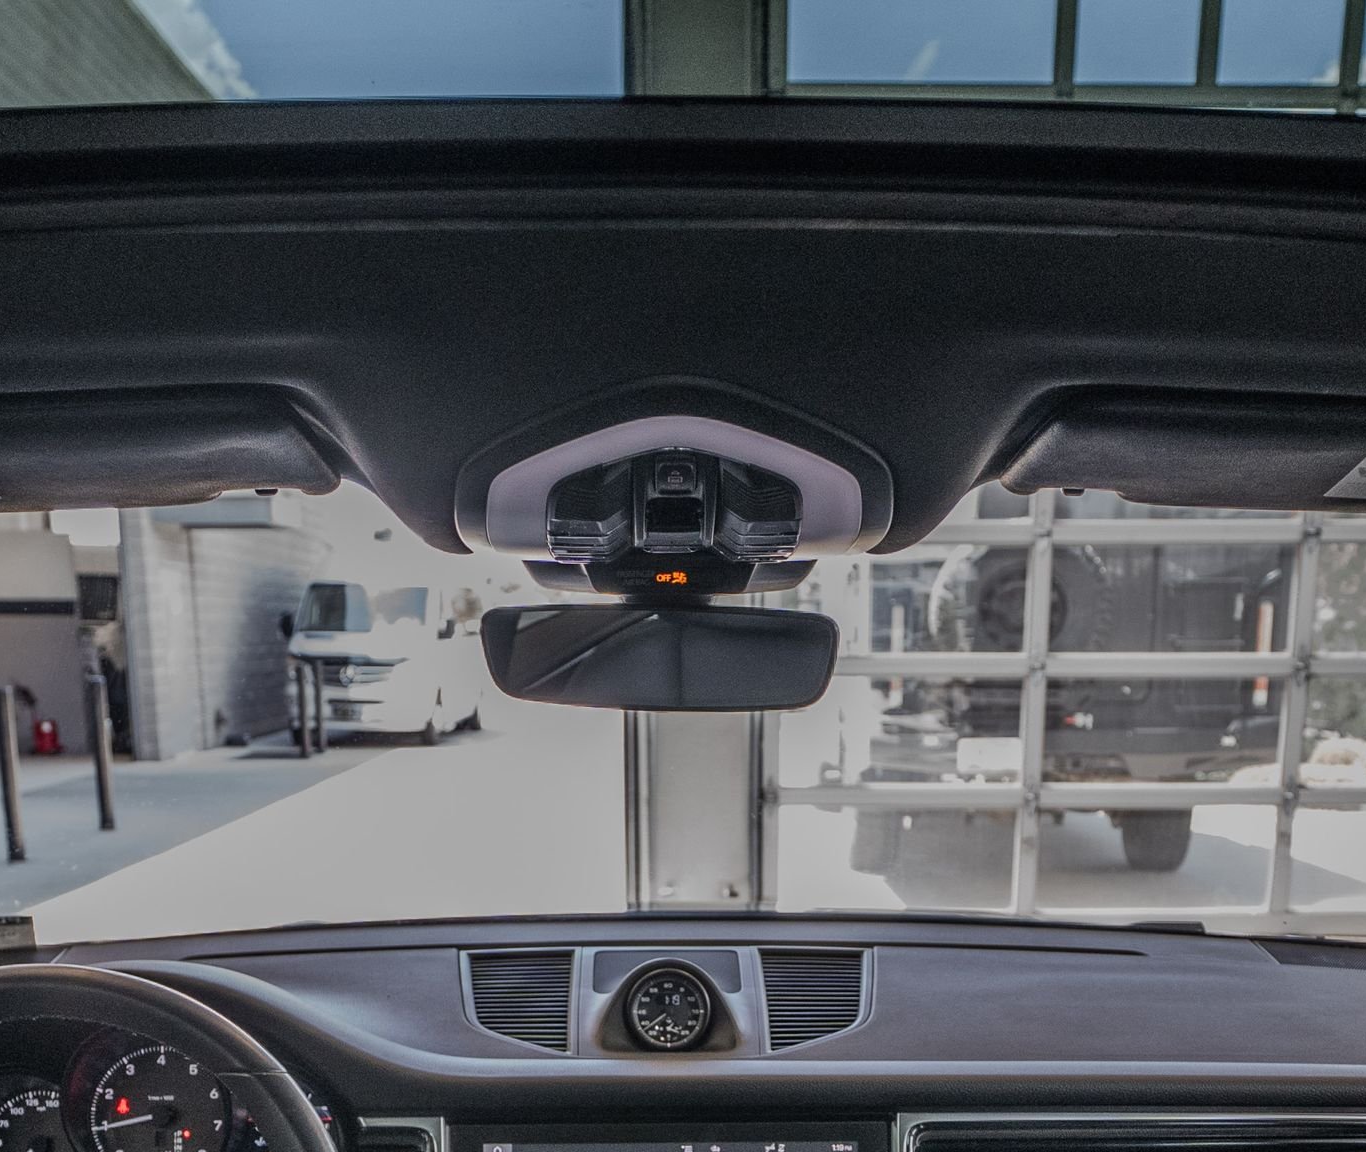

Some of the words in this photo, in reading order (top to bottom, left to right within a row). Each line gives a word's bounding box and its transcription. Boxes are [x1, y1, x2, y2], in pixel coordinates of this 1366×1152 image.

[656, 574, 671, 582] OFF
[156, 1055, 166, 1066] 4
[125, 1064, 135, 1075] 3
[189, 1064, 199, 1075] 5
[104, 1088, 114, 1100] 2
[209, 1088, 219, 1099] 6
[45, 1100, 59, 1108] 150
[10, 1107, 24, 1115] 100
[0, 1120, 9, 1128] 75
[213, 1120, 223, 1131] 7
